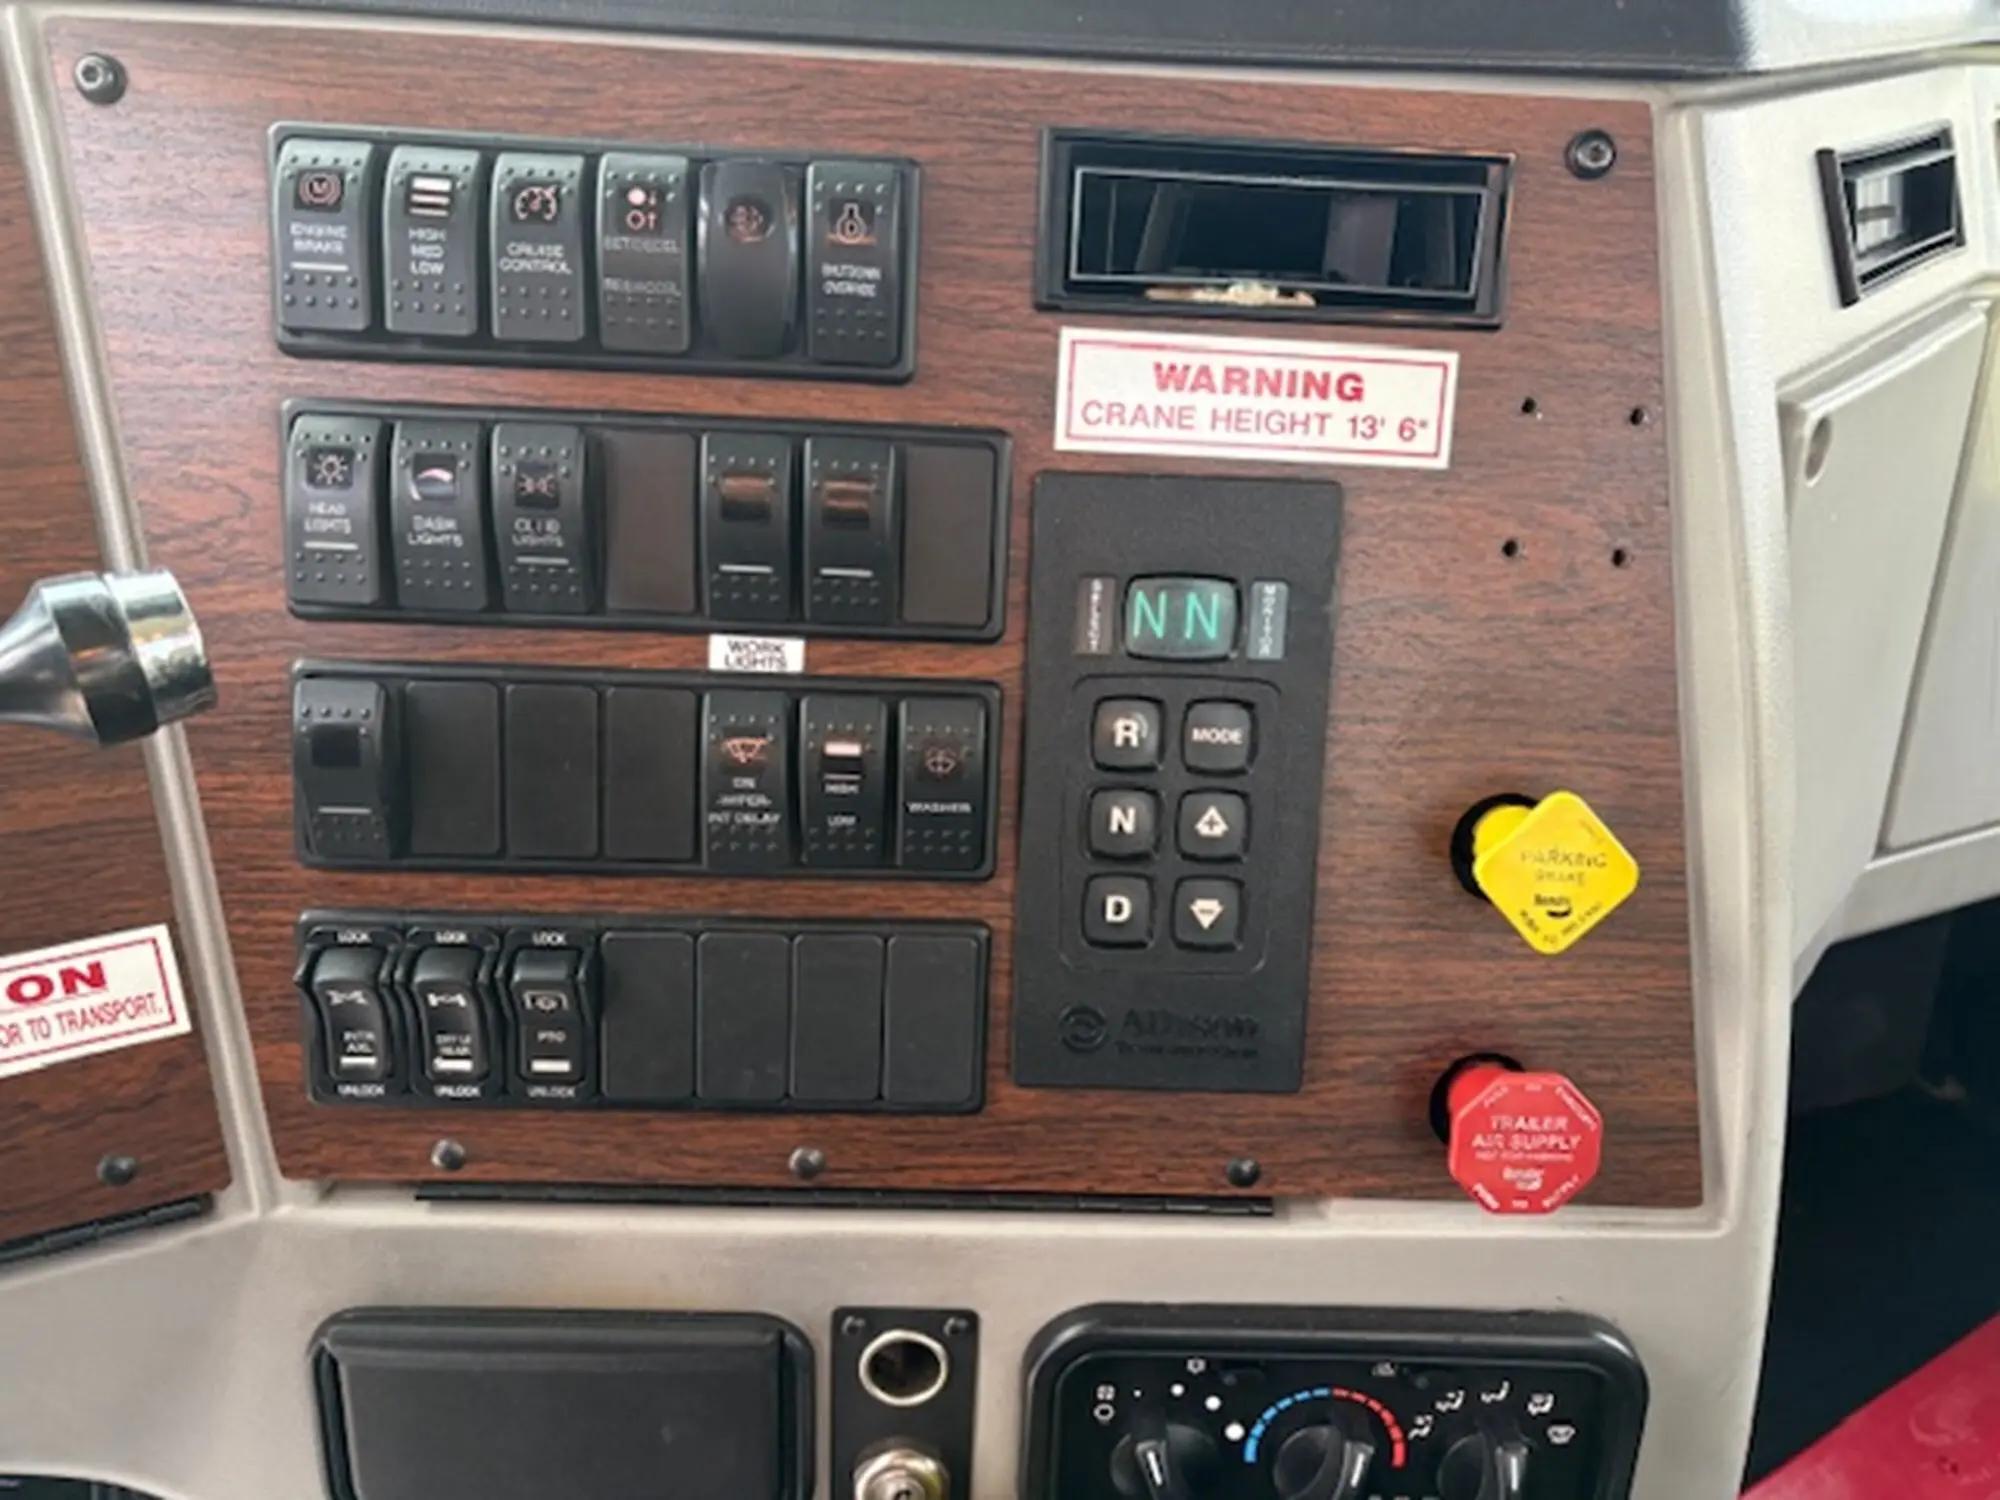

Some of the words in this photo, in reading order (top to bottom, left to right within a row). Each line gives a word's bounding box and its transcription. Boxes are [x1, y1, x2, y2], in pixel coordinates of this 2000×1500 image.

[409, 228, 446, 242] HIGH
[410, 243, 444, 258] MED
[506, 241, 564, 258] CRUISE
[410, 260, 445, 275] LOW
[500, 258, 573, 275] CONTROL
[1153, 361, 1365, 401] WARNING
[1081, 400, 1196, 430] CRANE
[1210, 408, 1333, 437] HEIGHT
[1346, 415, 1386, 440] 13'
[308, 502, 346, 516] HEAD
[304, 518, 352, 535] LIGHTS
[413, 515, 457, 530] DASH
[407, 531, 464, 547] LIGHTS
[727, 639, 785, 652] WORK
[724, 654, 788, 669] LIGHTS
[1113, 717, 1140, 748] R
[1192, 727, 1243, 745] MODE
[907, 802, 971, 814] WASHER
[827, 815, 856, 826] LOW
[1109, 805, 1136, 834] N
[1521, 847, 1607, 868] PARKING
[1105, 894, 1132, 923] D
[337, 931, 372, 943] LOCK
[435, 931, 469, 943] LOCK
[532, 932, 567, 945] LOCK
[6, 960, 107, 1005] ON
[27, 1014, 52, 1041] TO
[537, 1031, 566, 1043] PTO
[337, 1084, 385, 1096] UNLOCK
[434, 1085, 480, 1098] UNLOCK
[527, 1086, 575, 1098] UNLOCK
[1490, 1115, 1568, 1132] TRAILER
[1471, 1133, 1504, 1148] AIR
[1510, 1134, 1582, 1150] SUPPLY
